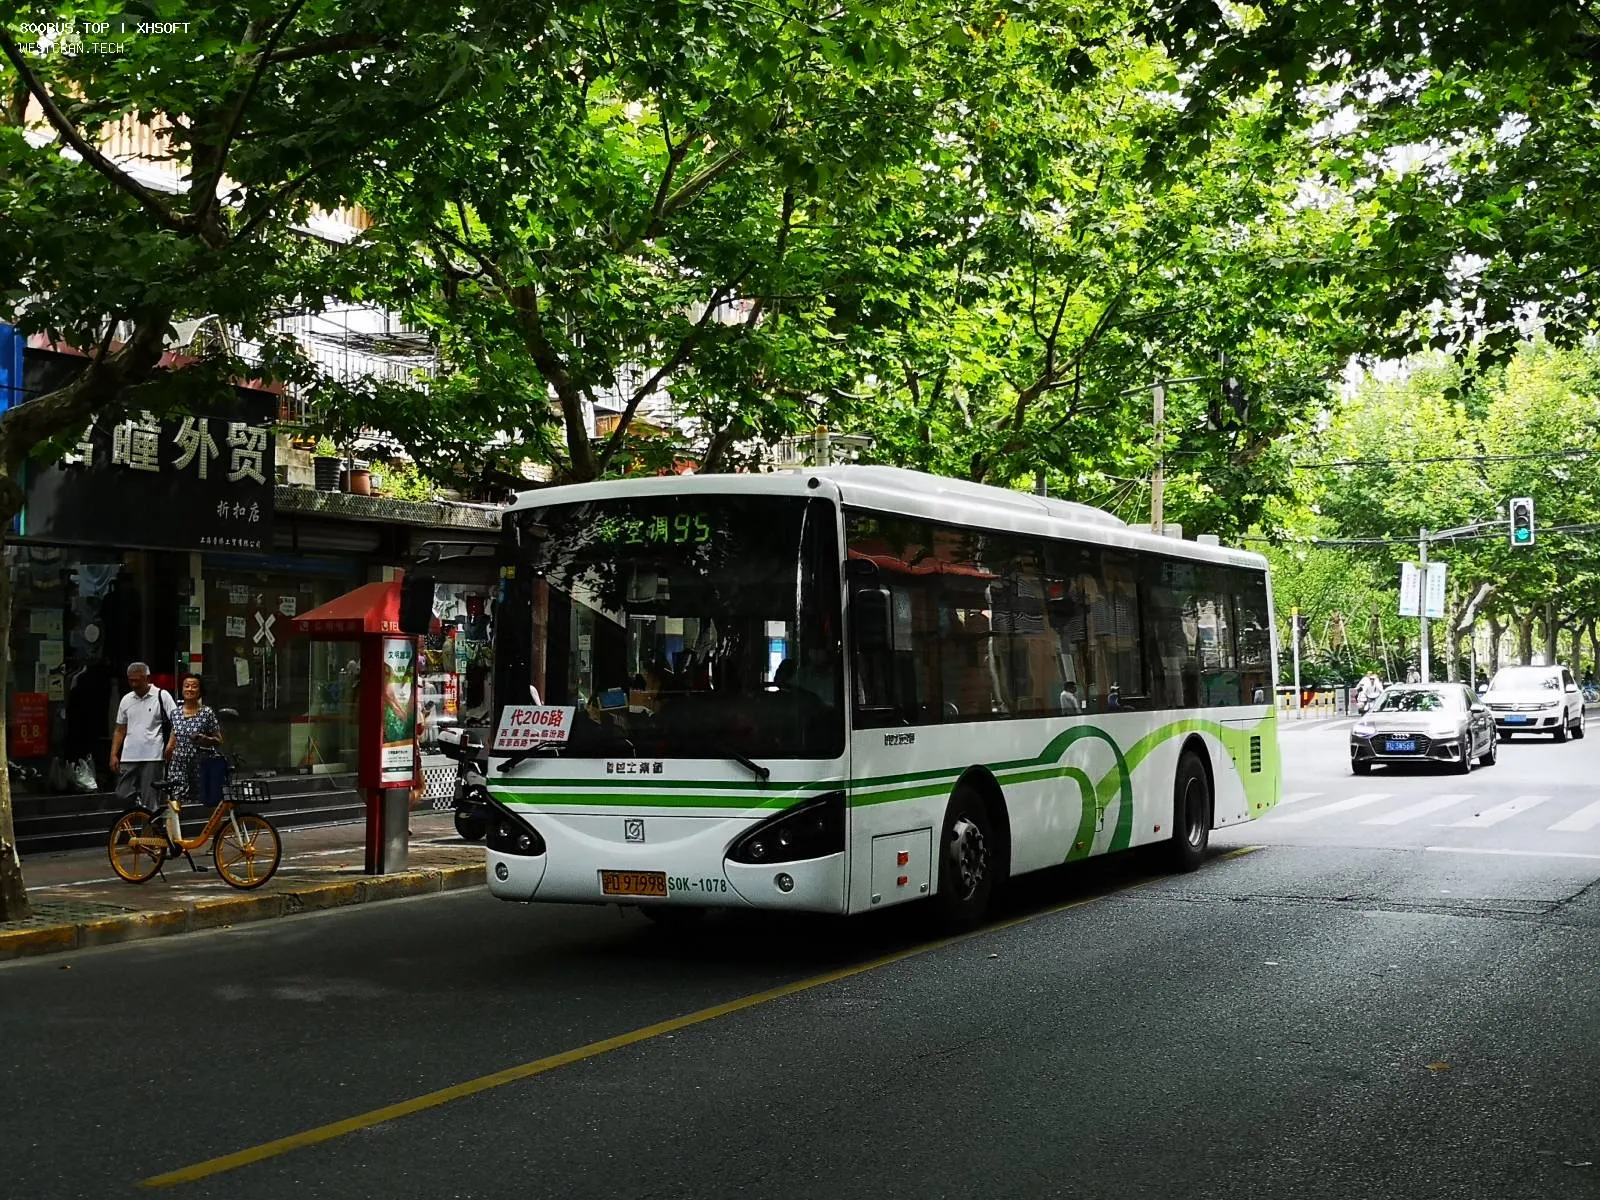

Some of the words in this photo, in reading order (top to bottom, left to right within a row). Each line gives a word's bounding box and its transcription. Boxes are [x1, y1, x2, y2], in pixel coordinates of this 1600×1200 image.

[216, 500, 261, 523] 折扣店
[510, 709, 564, 727] 代206路
